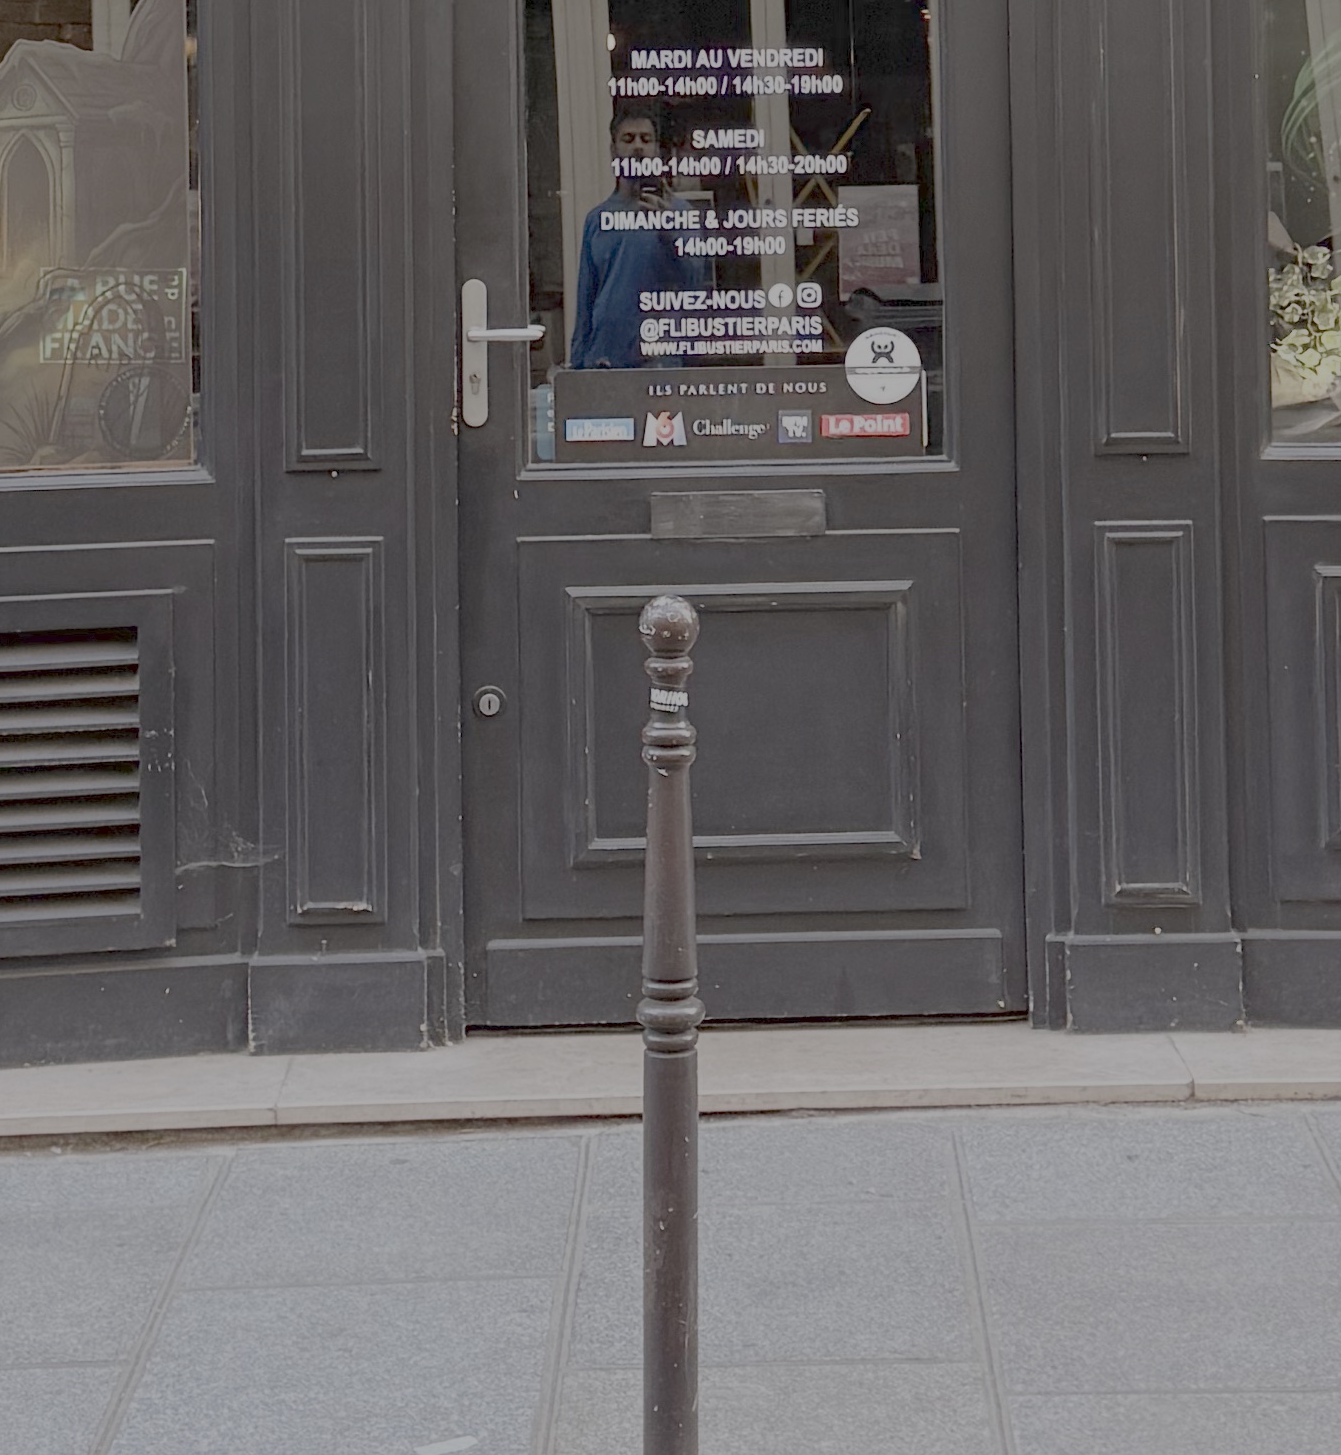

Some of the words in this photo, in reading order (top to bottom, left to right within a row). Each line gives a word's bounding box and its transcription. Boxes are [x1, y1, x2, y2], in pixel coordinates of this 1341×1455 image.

[631, 49, 692, 69] MARDI
[695, 49, 722, 68] AU
[726, 47, 824, 68] VENDREDI
[608, 76, 718, 96] 11h00-14h00
[732, 74, 843, 95] 14h30-19h00
[692, 129, 765, 149] SAMEDI
[611, 157, 720, 177] 11h00-14h00
[736, 154, 848, 175] 14h30-20h00
[600, 209, 700, 231] DIMANCHE
[705, 209, 719, 229] &
[723, 208, 788, 229] JOURS
[792, 203, 860, 228] FERIÉS
[674, 236, 786, 257] 14h00-19h00
[639, 290, 767, 312] SUIVEZ-NOUS
[639, 316, 823, 341] @FLIBUSTIERPARIS
[640, 340, 824, 357] WWW.FLIBUSTIERPARIS.COM
[647, 384, 673, 397] ILS
[678, 383, 748, 396] PARLENT
[756, 382, 776, 395] DE
[783, 381, 828, 394] NOUS
[828, 415, 851, 433] Le
[854, 413, 904, 432] Point
